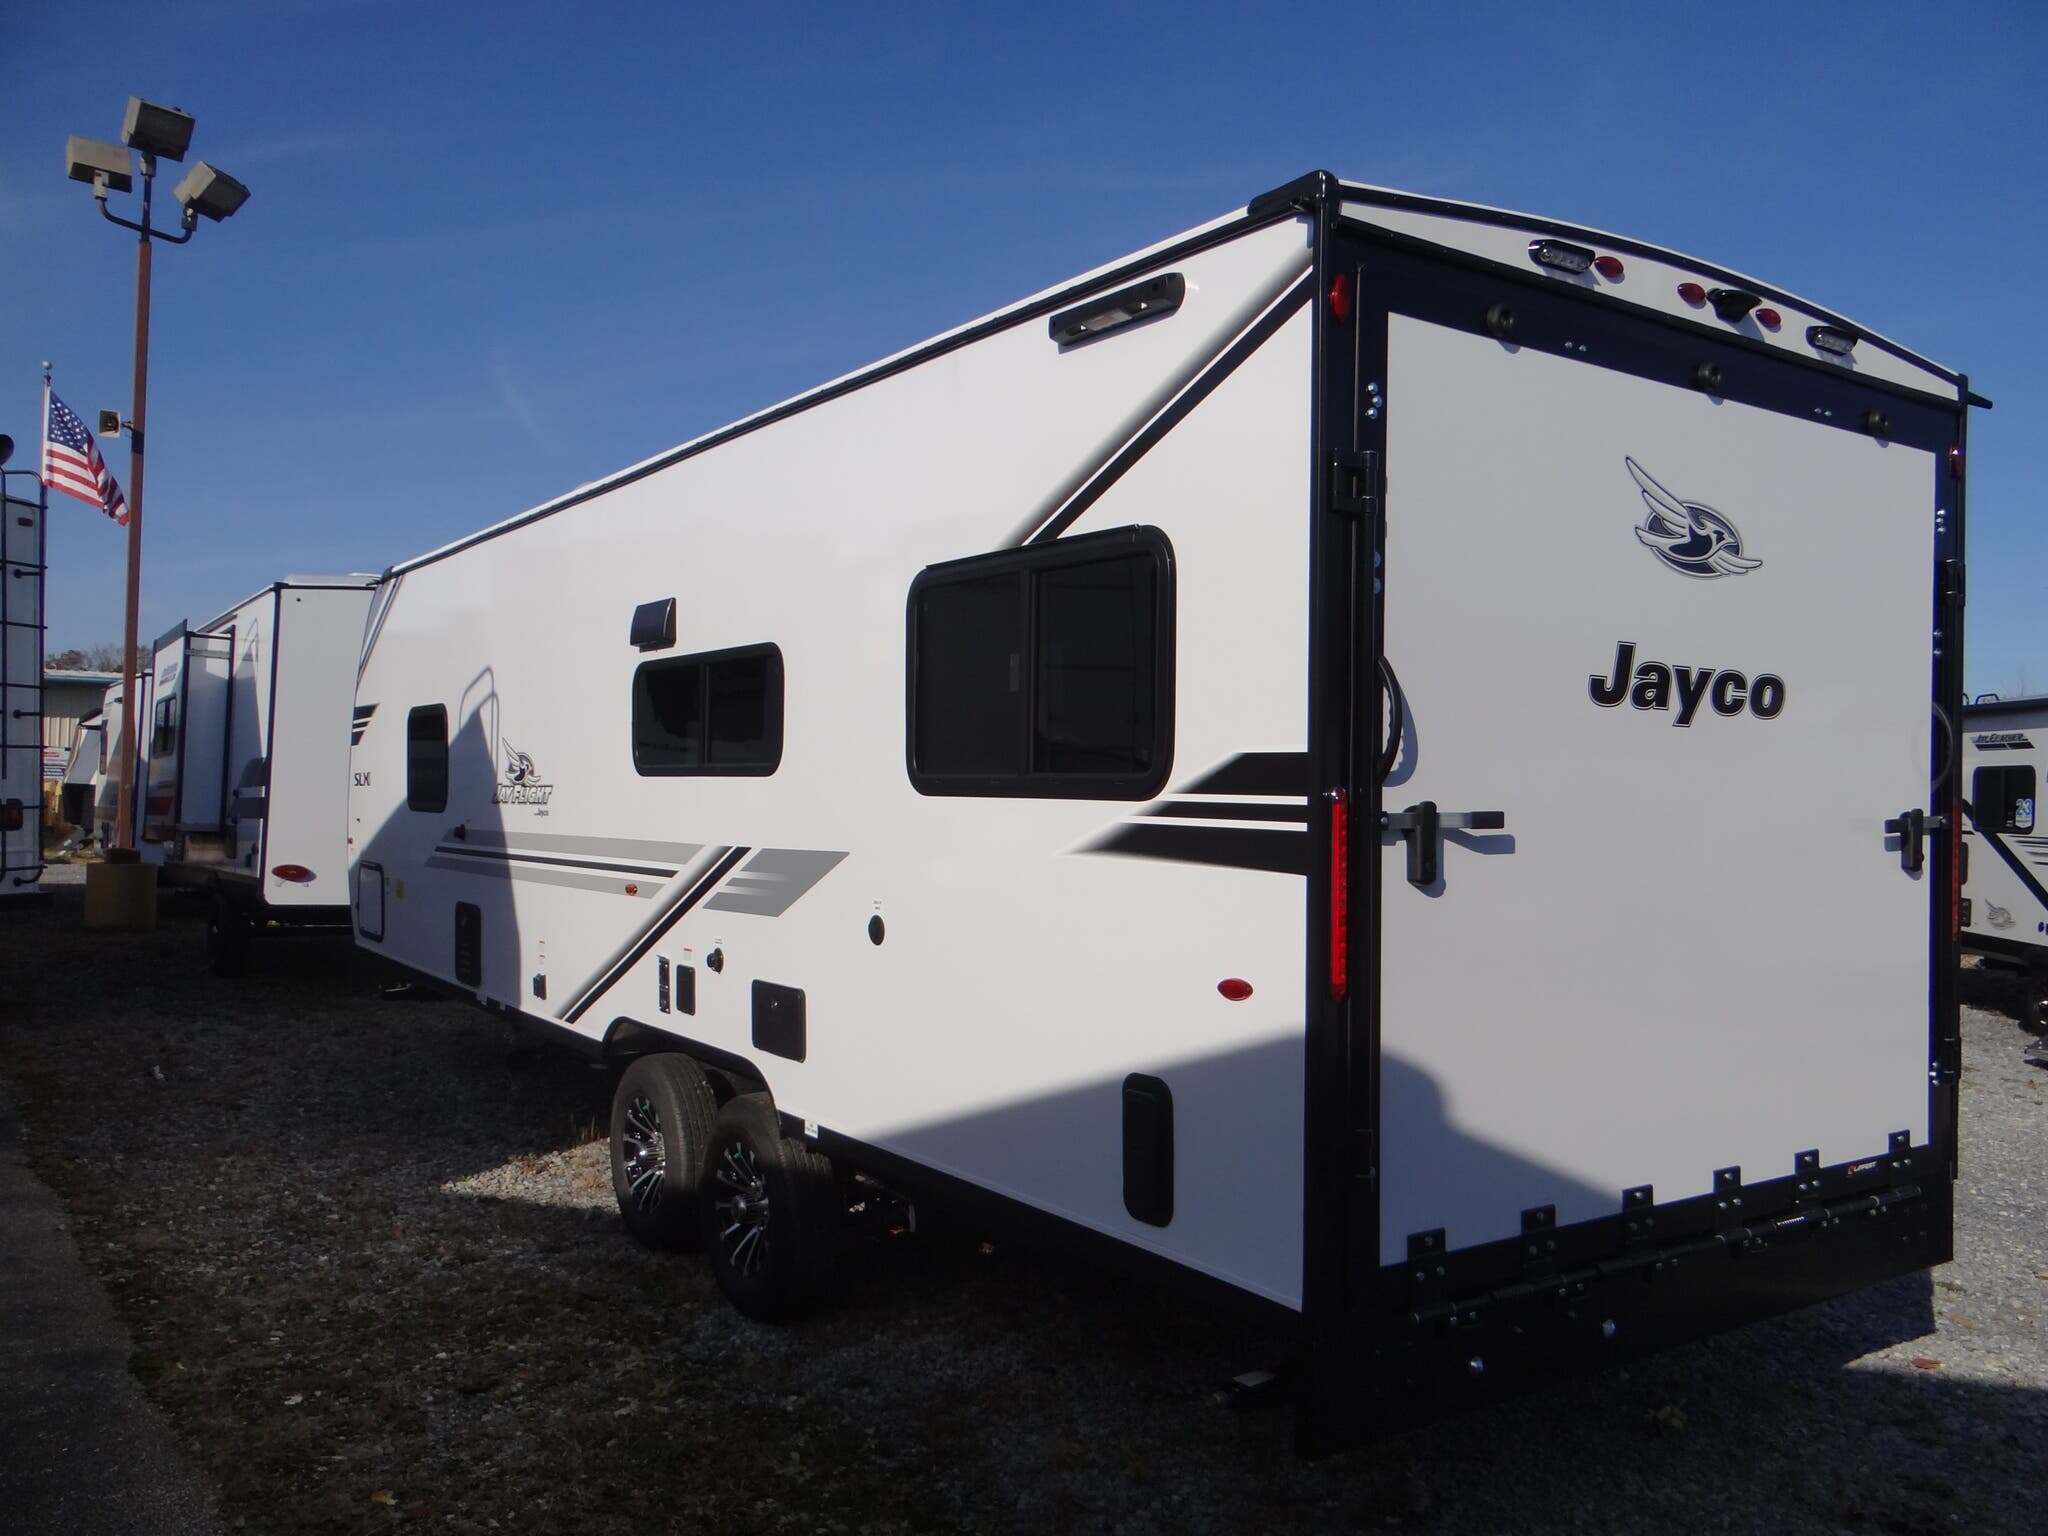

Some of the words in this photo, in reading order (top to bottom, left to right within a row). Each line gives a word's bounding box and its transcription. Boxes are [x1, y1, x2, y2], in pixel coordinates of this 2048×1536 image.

[1588, 640, 1786, 728] Jayco
[354, 772, 371, 786] SLX
[492, 783, 514, 804] JAY
[513, 784, 553, 804] FLIGHT
